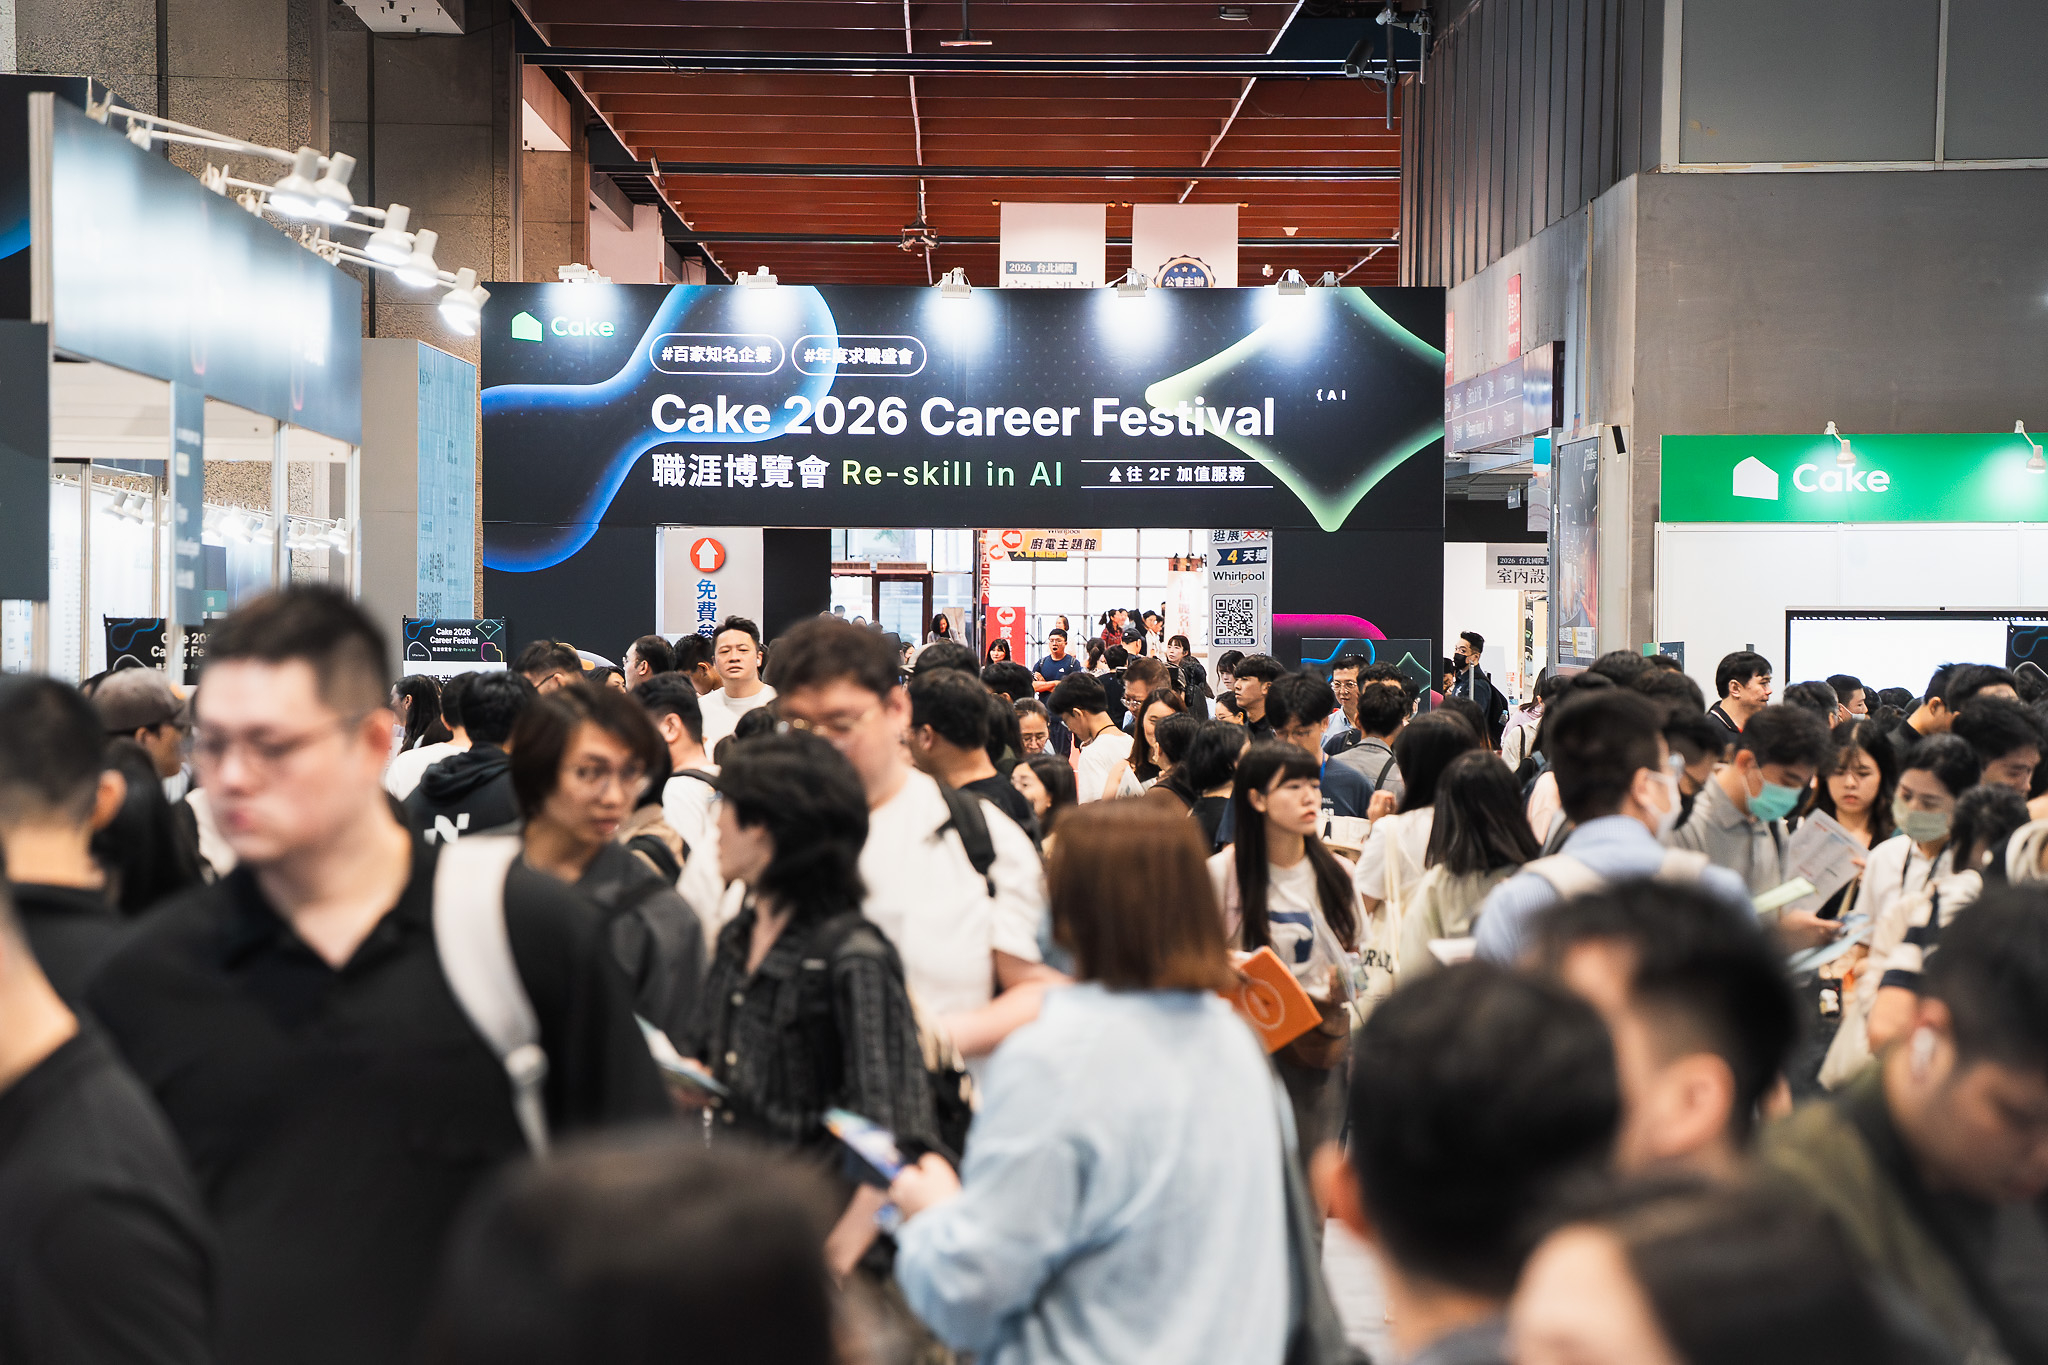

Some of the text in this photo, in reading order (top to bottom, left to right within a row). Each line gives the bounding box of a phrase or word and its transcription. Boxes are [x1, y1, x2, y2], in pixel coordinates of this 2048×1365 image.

[1009, 262, 1074, 273] 2026 台北國際
[551, 316, 615, 337] Cake
[662, 346, 772, 364] #百家知名企業
[804, 348, 915, 365] #年度求職盛會
[651, 394, 1275, 437] Cake 2026 Career Festival
[651, 453, 1062, 488] 職涯博覽會 Re-skill in AI
[1126, 465, 1246, 482] 往 2F 加值服務
[1793, 464, 1890, 493] Cake
[1030, 538, 1097, 550] 廚電主題館
[1227, 549, 1238, 564] 4
[1213, 571, 1265, 583] Whirlpool
[1497, 568, 1549, 584] 室內設
[161, 633, 189, 644] Ce
[435, 628, 472, 636] Cake 2026
[430, 636, 479, 645] Career Festival
[151, 646, 189, 657] Car
